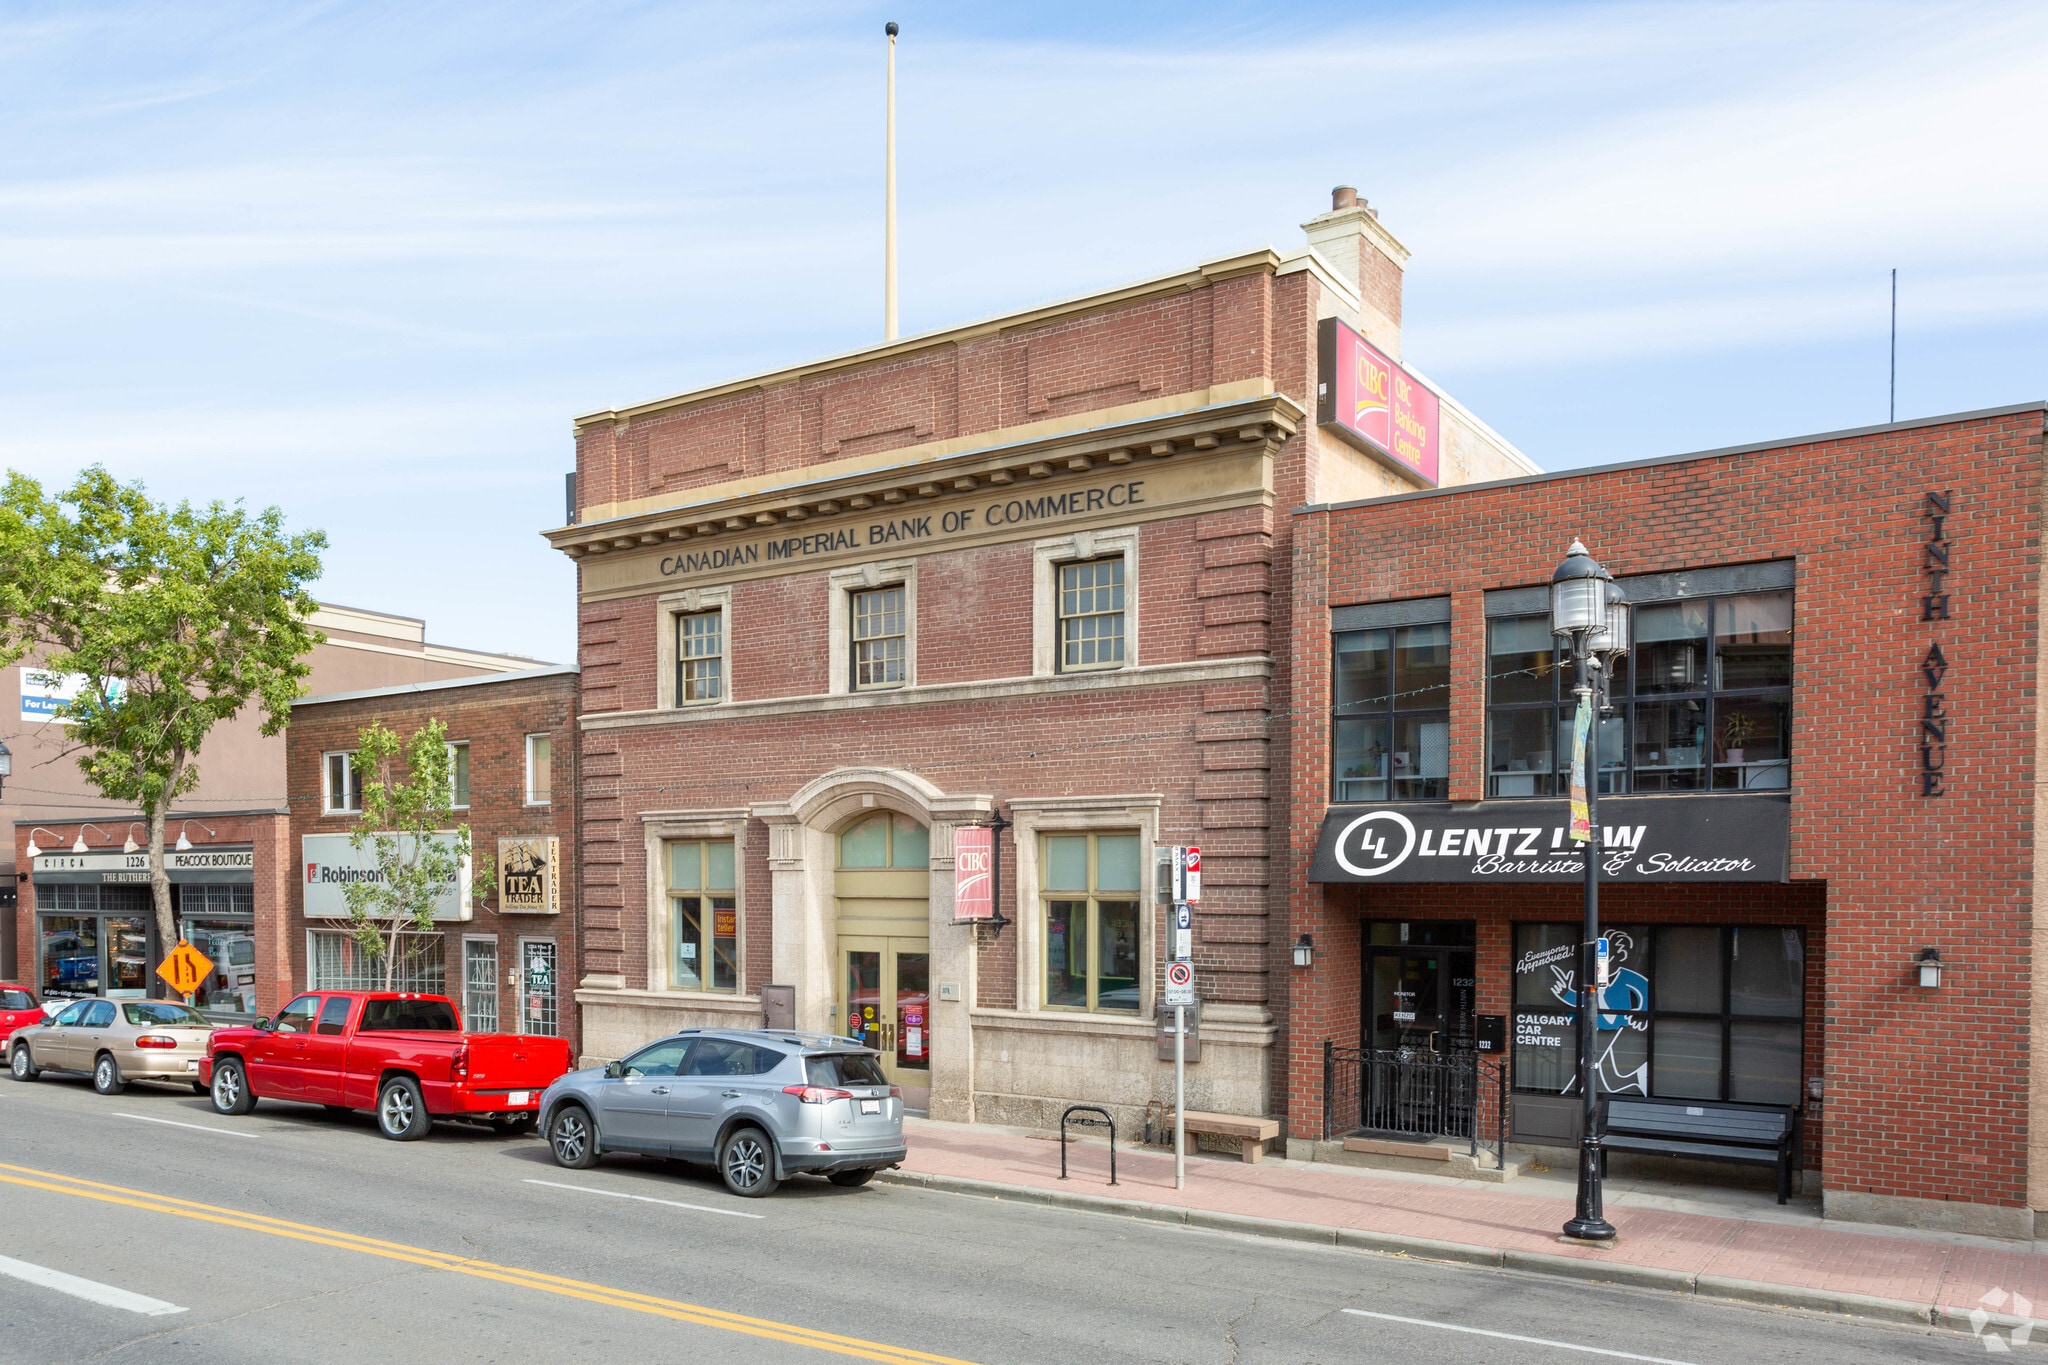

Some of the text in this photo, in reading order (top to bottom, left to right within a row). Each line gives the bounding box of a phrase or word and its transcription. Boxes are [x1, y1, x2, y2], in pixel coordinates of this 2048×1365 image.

[1358, 356, 1387, 401] CIBC
[1394, 375, 1412, 408] CIBC
[1394, 404, 1426, 448] Banking
[1394, 431, 1421, 465] Centre
[660, 481, 1145, 577] CANADIAN IMPERIAL BANK OF COMMERCE
[1920, 489, 1953, 798] NINTH AVENUE
[25, 699, 41, 710] For
[1418, 826, 1647, 856] LENTZ LW
[44, 858, 84, 868] CIRCA
[126, 856, 146, 868] 1226
[175, 854, 252, 867] PEACOCK BOUTIQUE
[959, 852, 988, 871] CIBC
[1471, 853, 1756, 876] Barriste & Solicitor
[102, 872, 118, 882] THE
[322, 866, 384, 883] Robinson
[506, 876, 541, 893] TEA
[505, 893, 543, 903] TRADER
[1516, 945, 1575, 974] Approved!
[1525, 945, 1568, 961] Everyone
[531, 974, 549, 985] TEA
[1453, 978, 1474, 987] 1232
[1516, 1014, 1573, 1026] CALGARY
[1516, 1025, 1541, 1035] CAR
[1479, 1040, 1492, 1049] 1232
[1516, 1035, 1561, 1046] CENTRE
